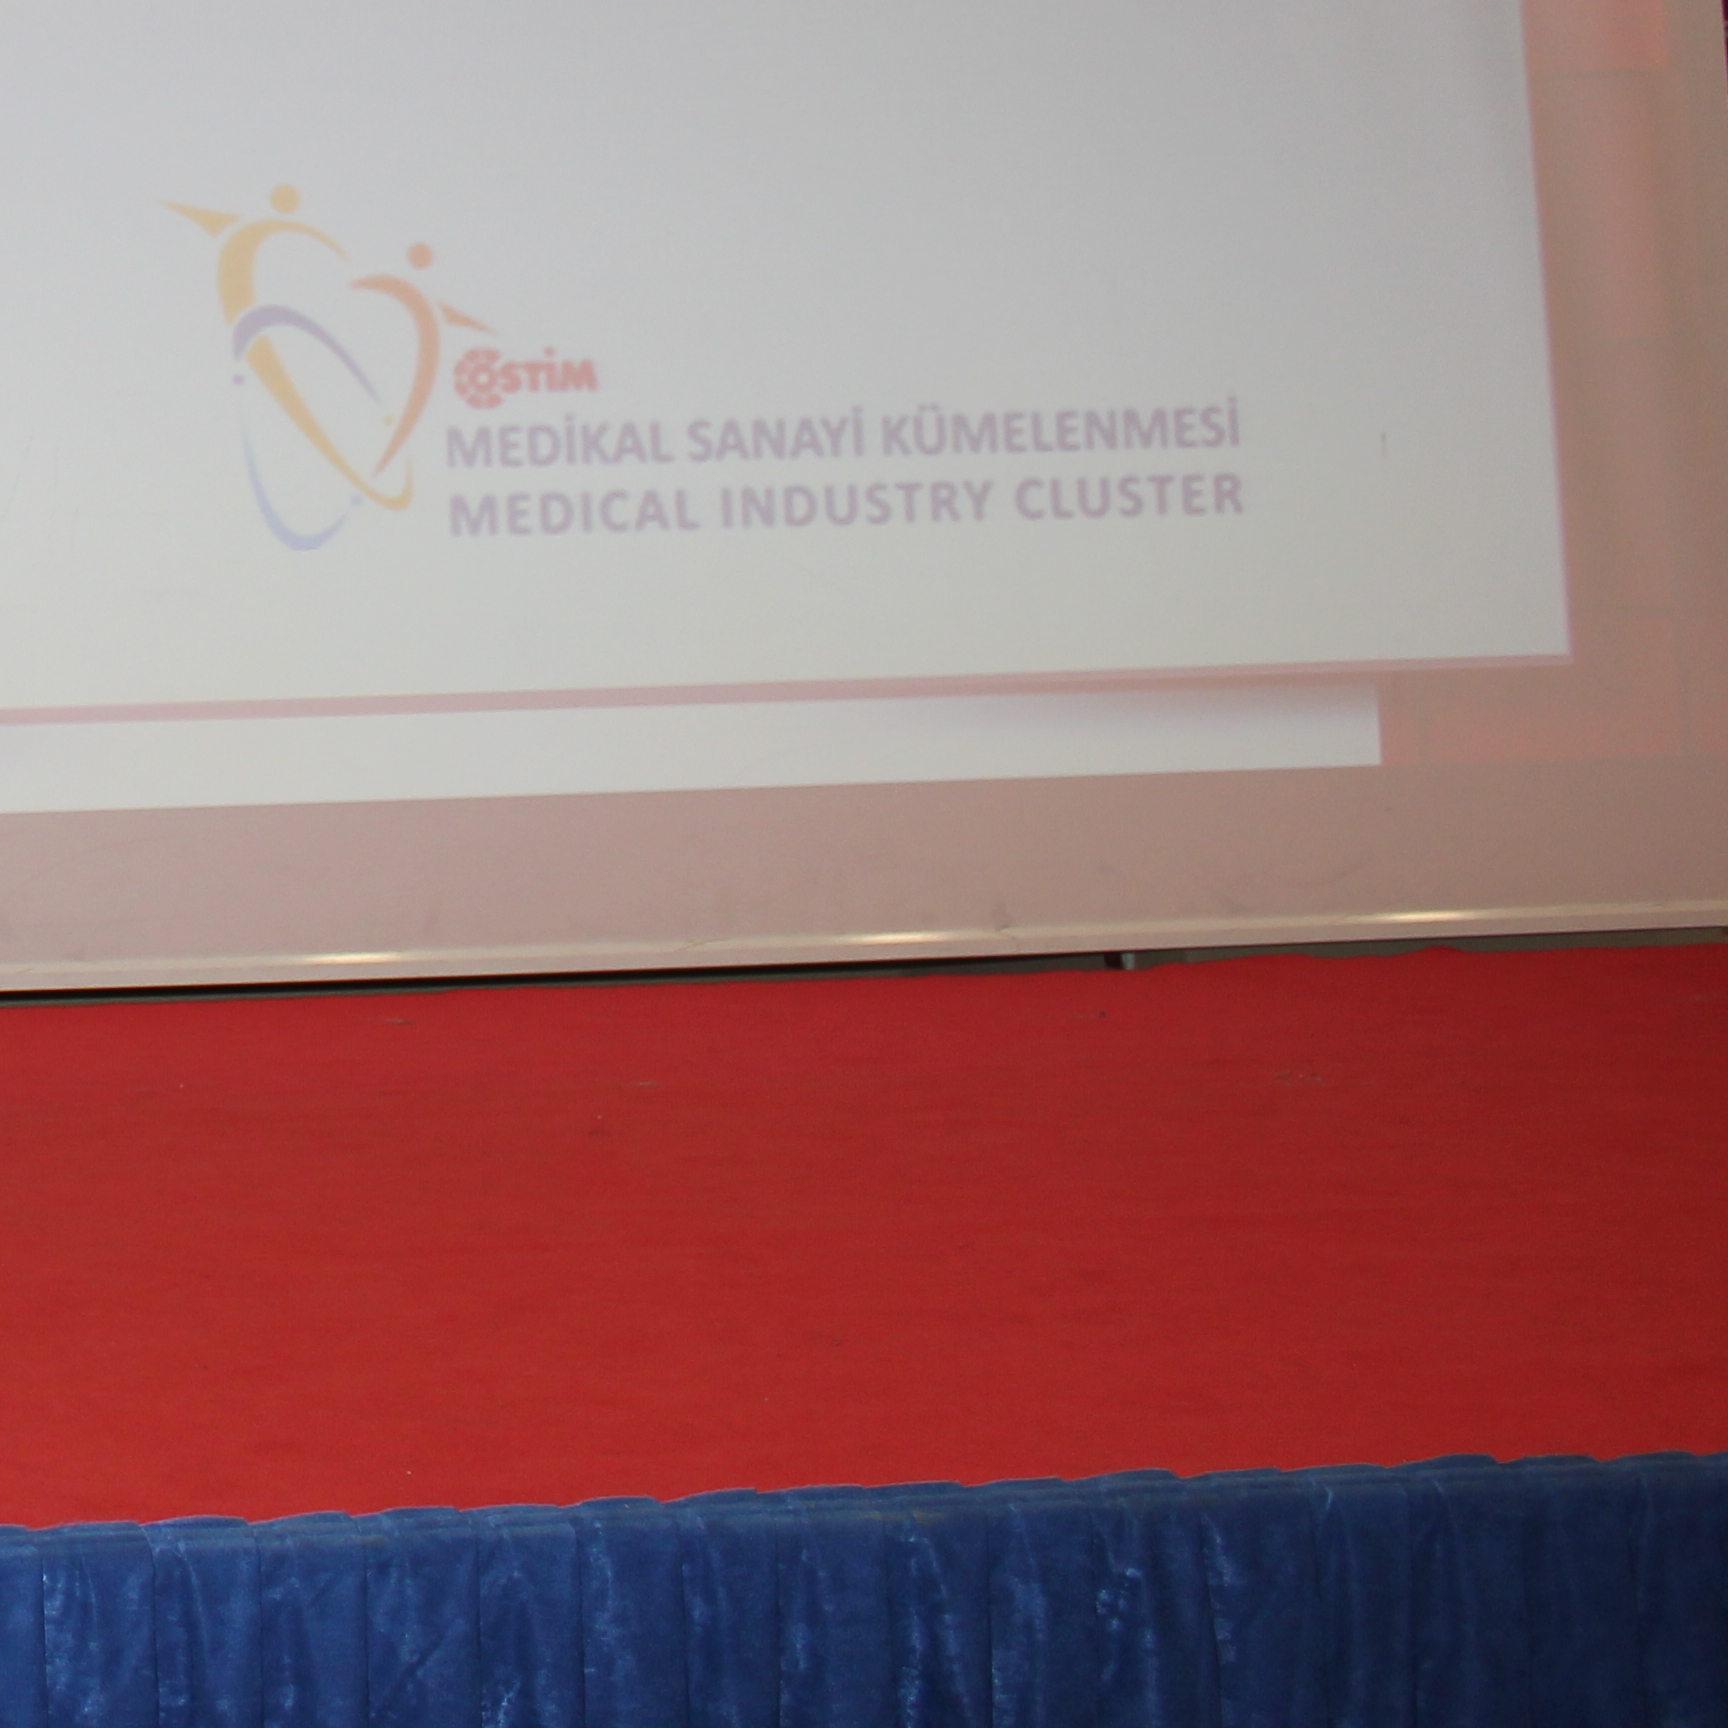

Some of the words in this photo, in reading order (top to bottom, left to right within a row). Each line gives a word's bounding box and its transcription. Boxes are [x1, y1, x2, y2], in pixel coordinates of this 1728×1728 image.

[445, 412, 674, 468] MEDİKAL
[688, 405, 865, 461] SANAYİ
[880, 392, 1242, 456] KÜMELENMESİ
[449, 488, 704, 537] MEDICAL
[721, 479, 993, 529] INDUSTRY
[1014, 473, 1244, 522] CLUSTER
